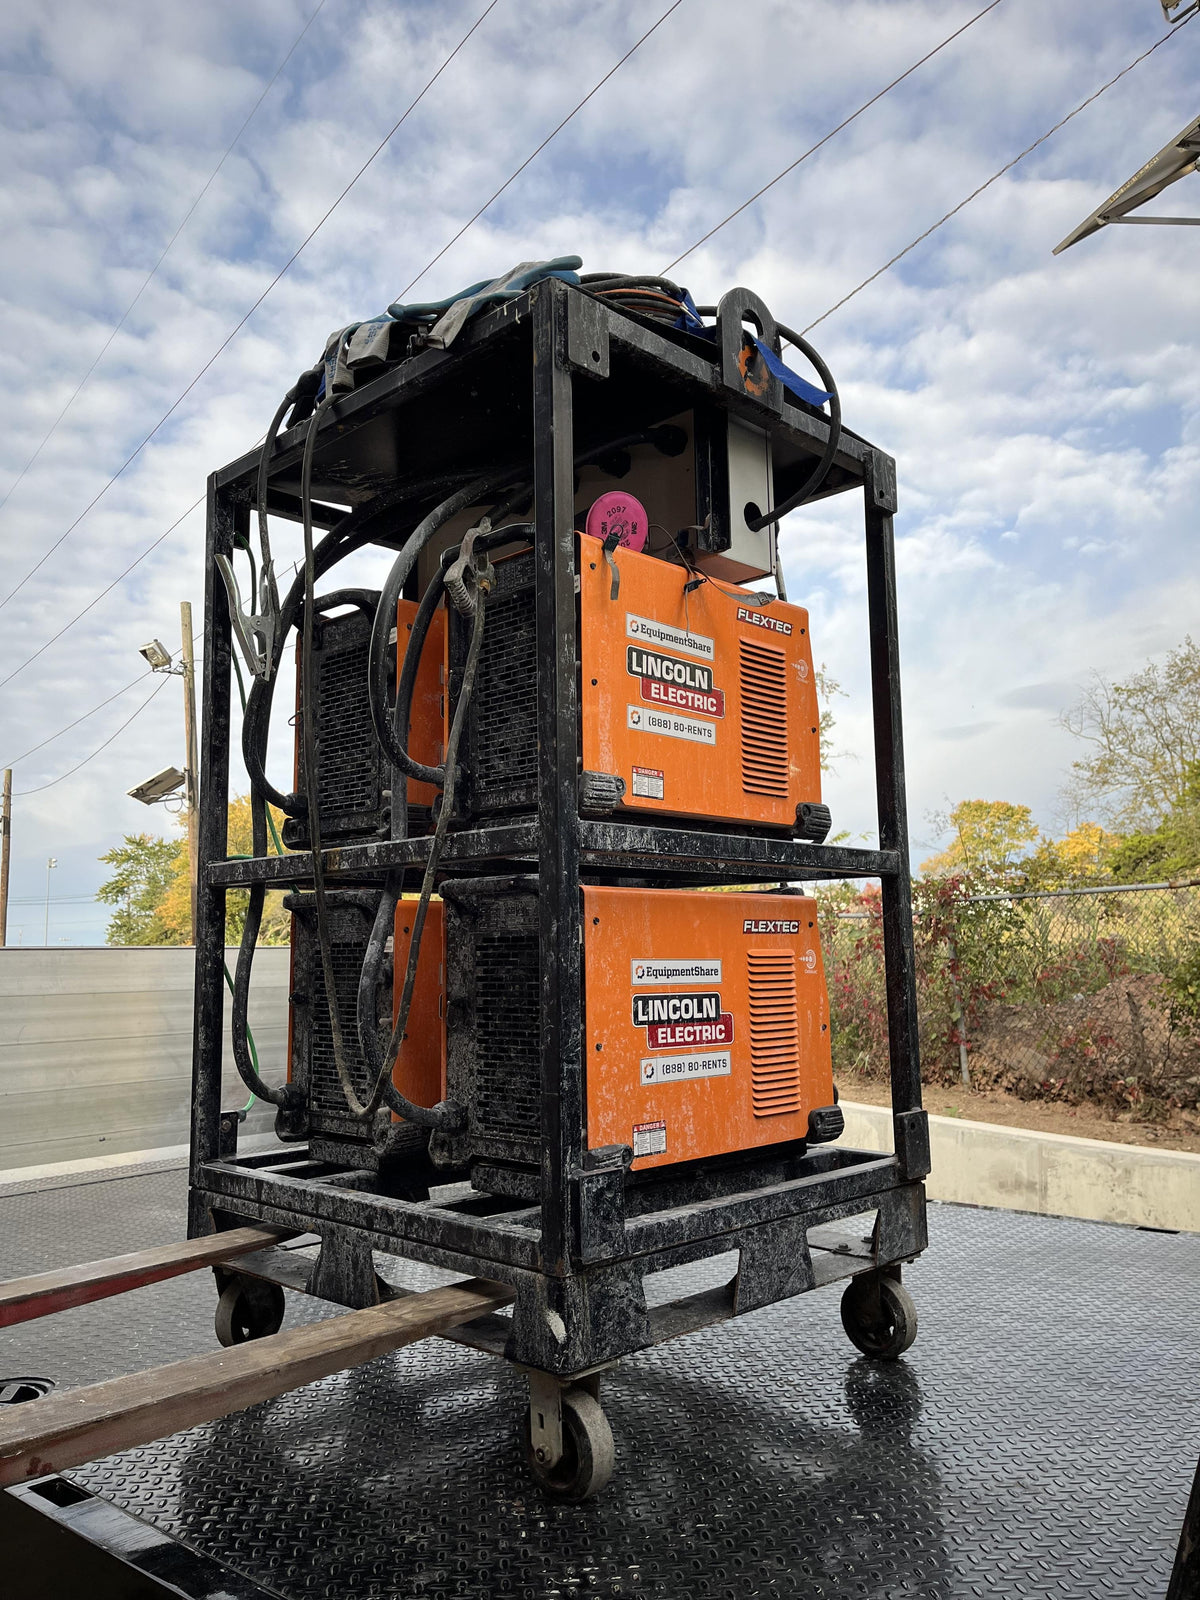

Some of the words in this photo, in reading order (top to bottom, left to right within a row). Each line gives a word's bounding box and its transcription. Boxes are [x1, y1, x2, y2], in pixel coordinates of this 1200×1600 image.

[606, 505, 627, 518] 2097
[600, 521, 608, 535] 3M
[631, 521, 638, 535] 3M
[737, 608, 792, 634] FLEXTEC
[640, 623, 712, 654] EquipmentShare
[631, 651, 709, 690] LINCOLN
[650, 682, 717, 713] ELECTRIC
[648, 715, 672, 731] (888)
[673, 718, 713, 739] 80-RENTS
[638, 767, 658, 777] DANGER
[743, 920, 799, 933] FLEXTEC
[646, 965, 719, 979] EquipmentShare
[637, 997, 716, 1021] LINCOLN
[657, 1024, 726, 1045] ELECTRIC
[661, 1061, 686, 1076] (888)
[688, 1058, 728, 1072] 80-RENTS
[639, 1122, 660, 1132] DANGER
